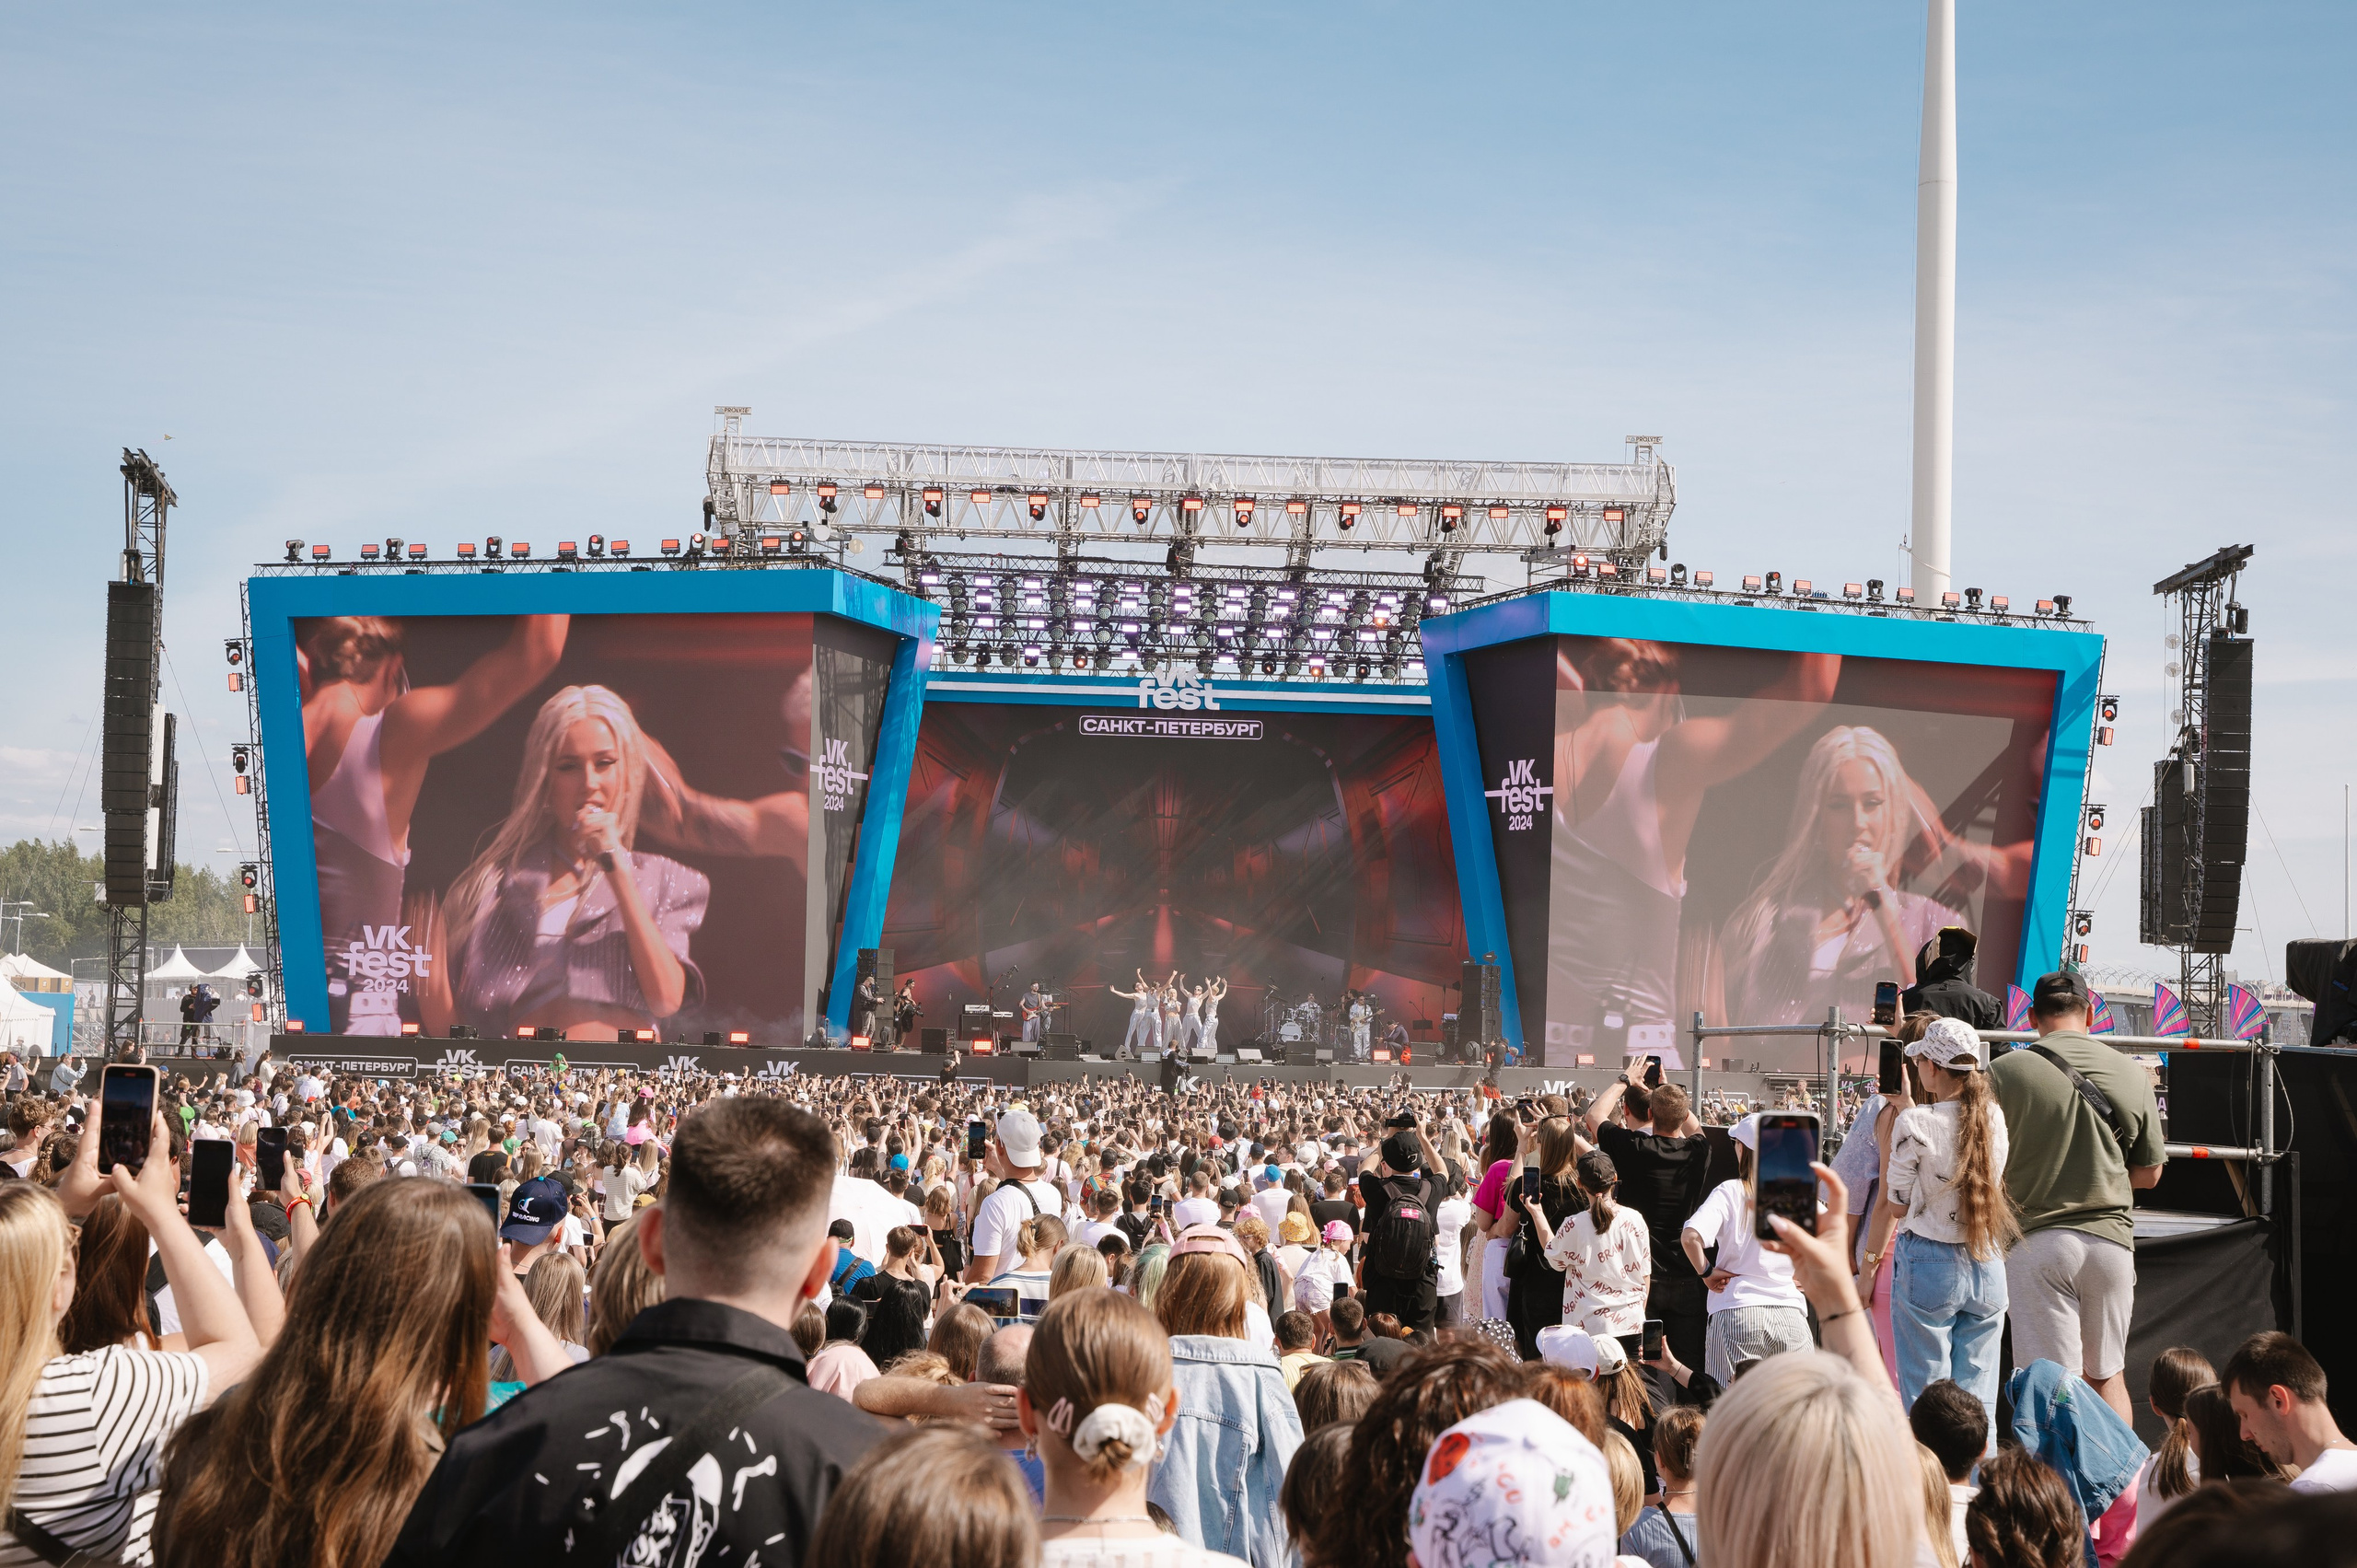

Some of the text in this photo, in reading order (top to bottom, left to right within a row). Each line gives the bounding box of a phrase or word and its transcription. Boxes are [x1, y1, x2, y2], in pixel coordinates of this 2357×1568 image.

[1154, 667, 1203, 688] VK
[1137, 679, 1221, 711] fest
[1083, 718, 1260, 737] САНКТ-ПЕТЕРБУРГ
[825, 738, 848, 766] VK
[816, 754, 856, 796] fest
[1508, 759, 1535, 785] VK
[824, 794, 844, 811] 2024
[1498, 777, 1545, 814] fest
[1508, 814, 1533, 830] 2024
[363, 924, 412, 950] VK
[343, 941, 433, 978] fest
[363, 978, 409, 993] 2024
[446, 1049, 477, 1064] VK
[668, 1055, 700, 1071] VK
[766, 1060, 800, 1076] VK
[1543, 1079, 1575, 1096] VK
[1596, 1238, 1624, 1264] BRAW
[1589, 1280, 1623, 1299] BRAW
